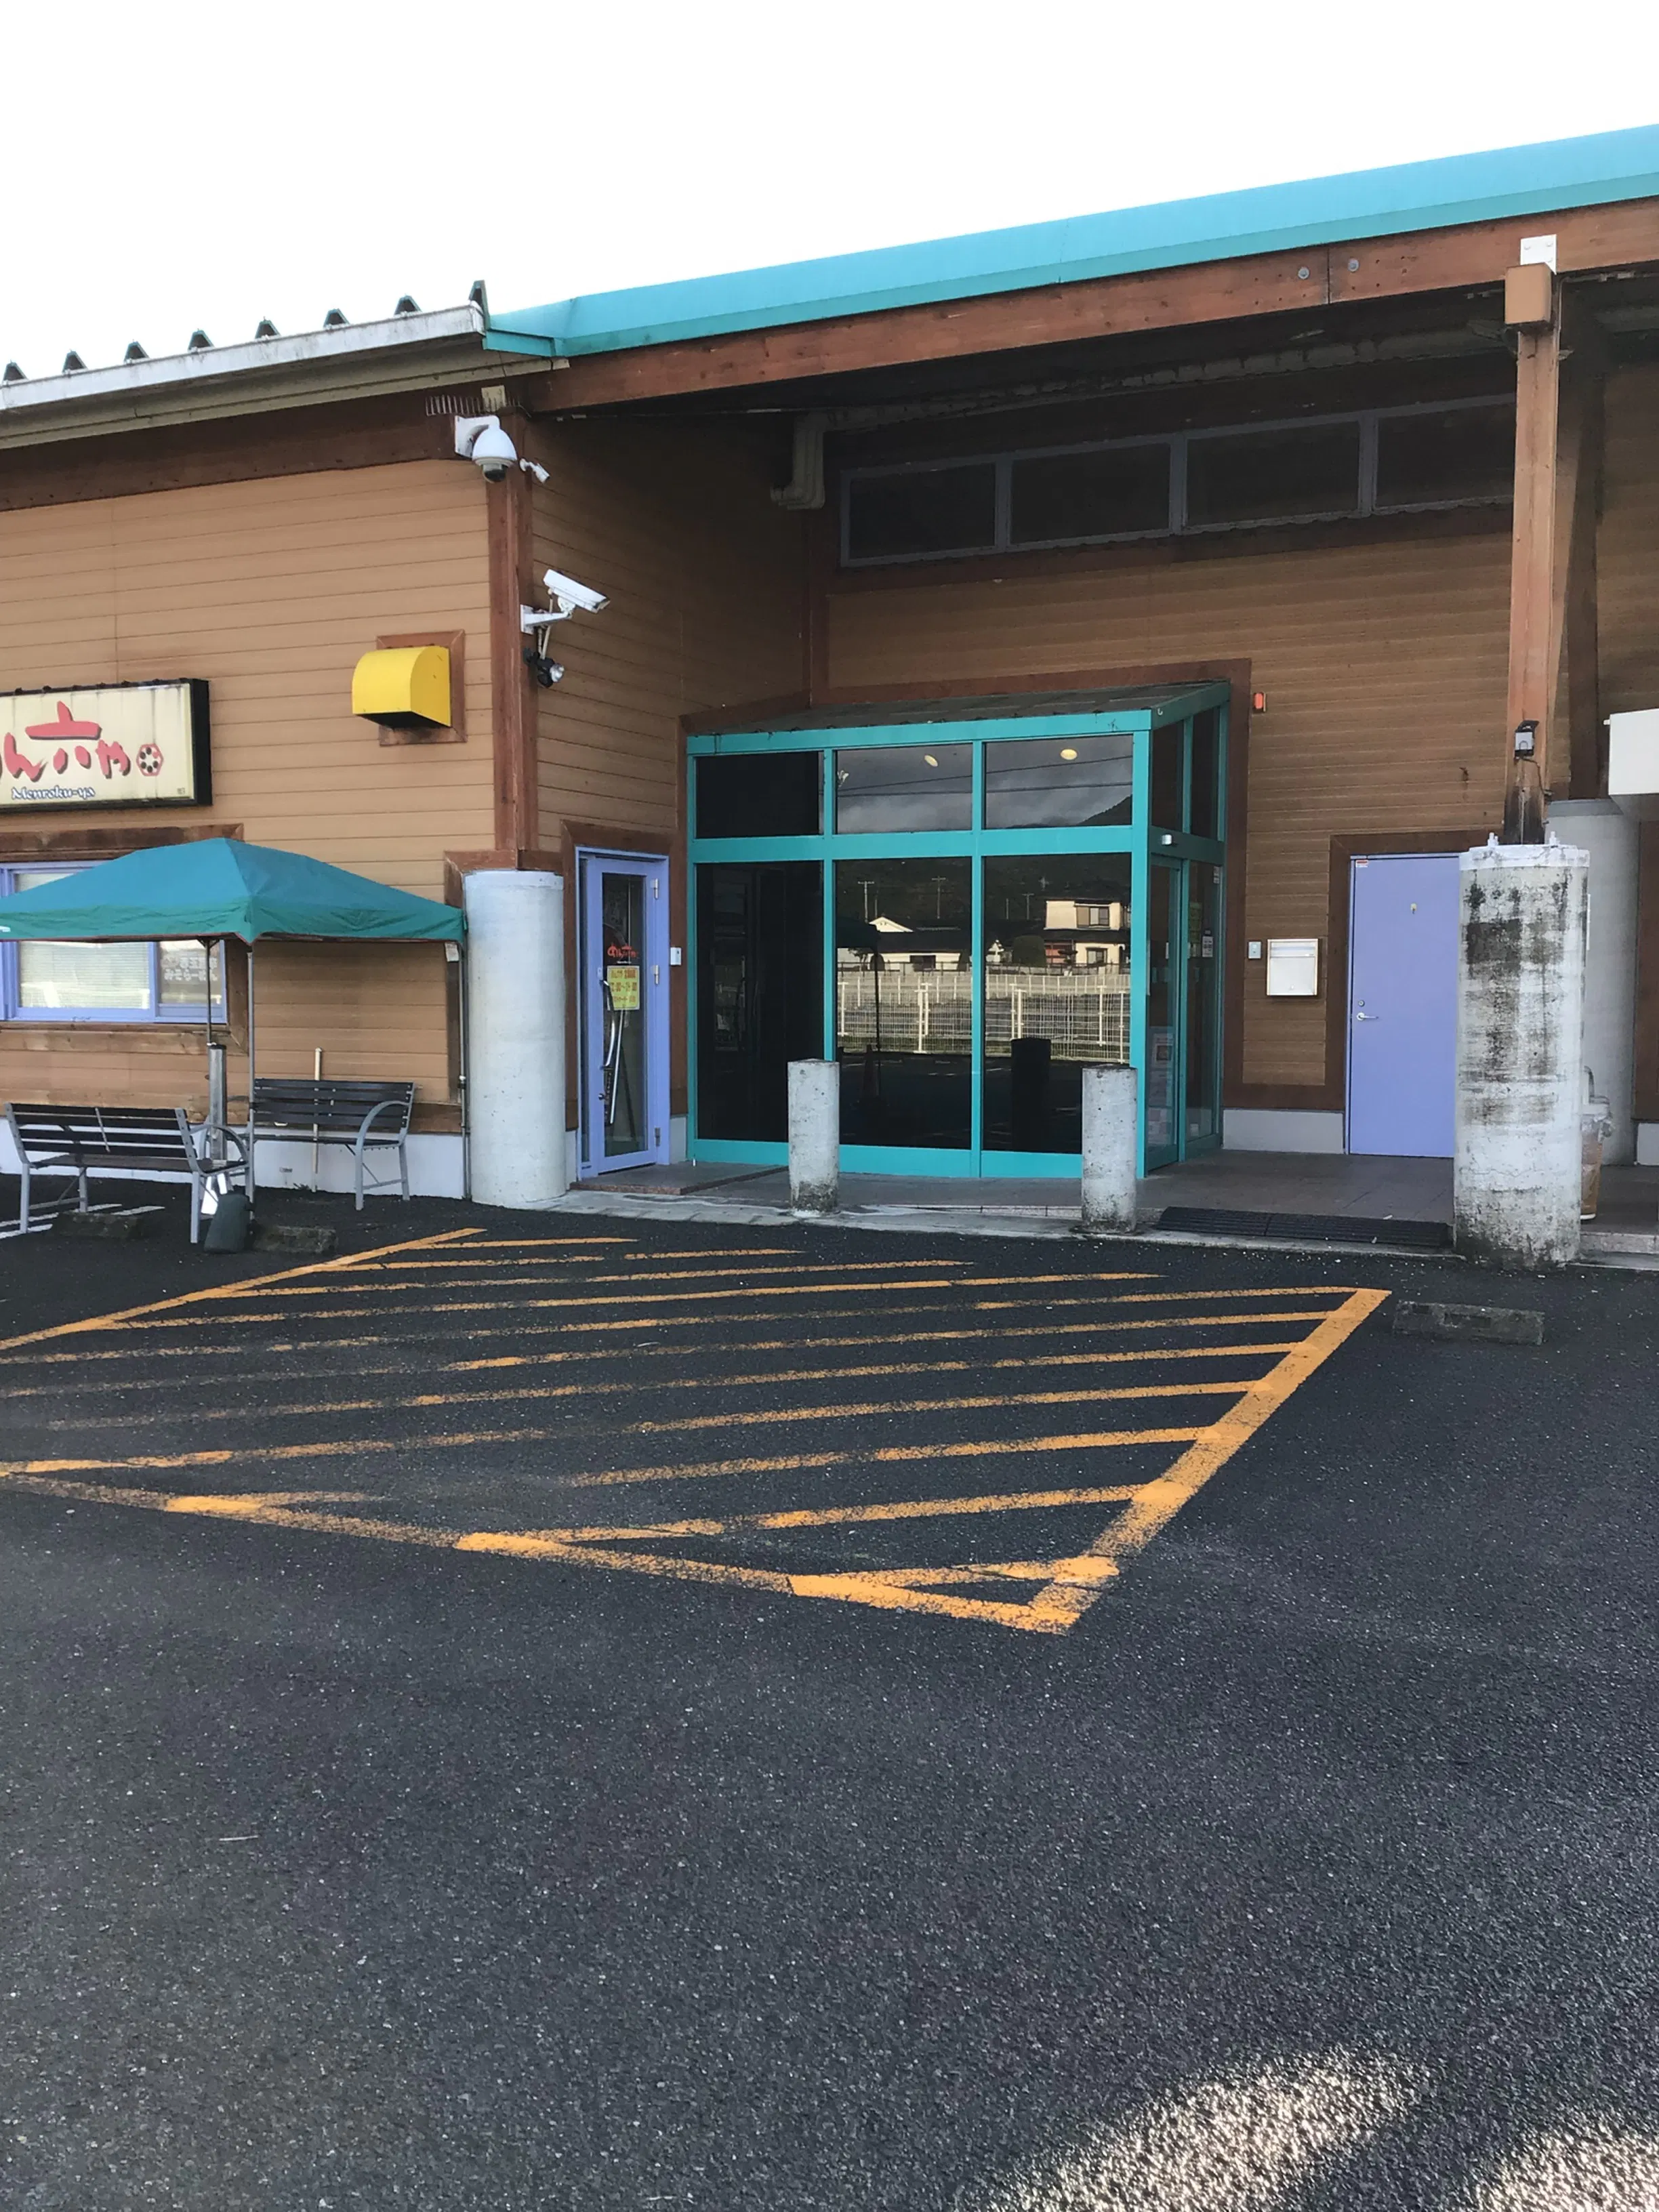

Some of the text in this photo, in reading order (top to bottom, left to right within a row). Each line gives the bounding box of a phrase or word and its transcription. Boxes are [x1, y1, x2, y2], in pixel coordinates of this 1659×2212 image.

[0, 700, 131, 783] ん六や
[11, 785, 96, 800] Menroku-ya
